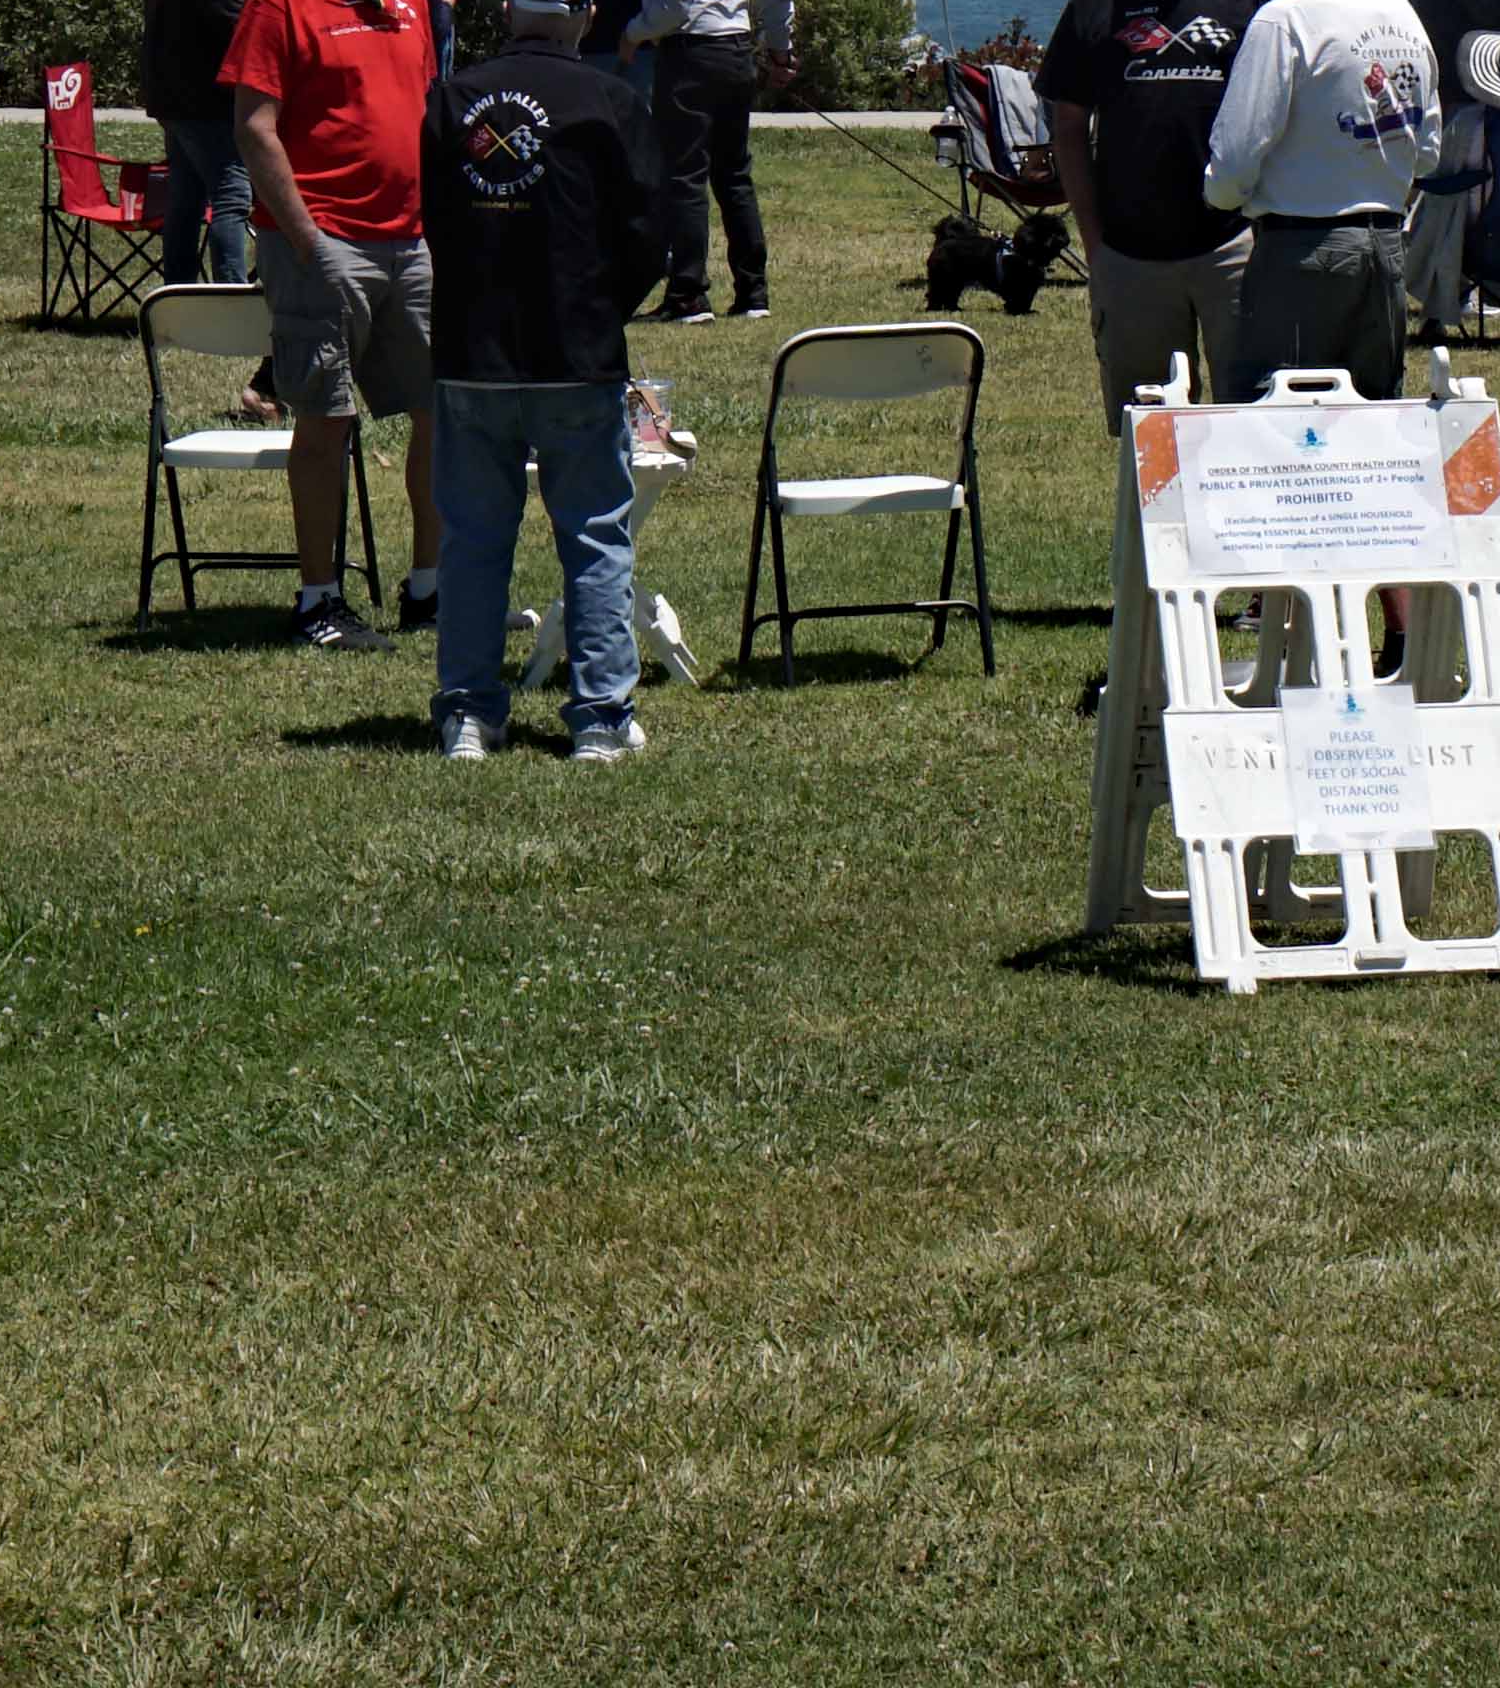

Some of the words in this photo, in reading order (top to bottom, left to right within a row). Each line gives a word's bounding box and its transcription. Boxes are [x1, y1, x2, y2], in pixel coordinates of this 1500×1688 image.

[1350, 28, 1376, 56] SIMI
[1123, 58, 1225, 81] Corvette
[463, 93, 496, 127] SIMI
[501, 91, 551, 128] VALLEY
[462, 163, 546, 196] CORVETTES
[1207, 467, 1237, 476] ORDER
[1239, 466, 1250, 475] OF
[1252, 465, 1269, 475] THE
[1270, 463, 1312, 474] VENTURA
[1314, 462, 1350, 472] COUNTY
[1352, 460, 1384, 470] HEALTH
[1386, 459, 1421, 469] OFFICER
[1199, 481, 1236, 491] PUBLIC
[1238, 480, 1246, 489] &
[1249, 478, 1292, 489] PRIVATE
[1295, 475, 1360, 488] GATHERINGS
[1363, 474, 1373, 484] of
[1391, 473, 1425, 484] People
[1276, 490, 1354, 506] PROHIBITED
[1330, 730, 1376, 744] PLEASE
[1314, 748, 1372, 761] OBSERVE
[1373, 747, 1396, 761] SIX
[1307, 767, 1337, 780] FEET
[1340, 767, 1359, 779] OF
[1362, 765, 1408, 779] SOCIAL
[1320, 784, 1400, 798] DISTANCING
[1324, 802, 1368, 816] THANK
[1371, 801, 1400, 814] YOU
